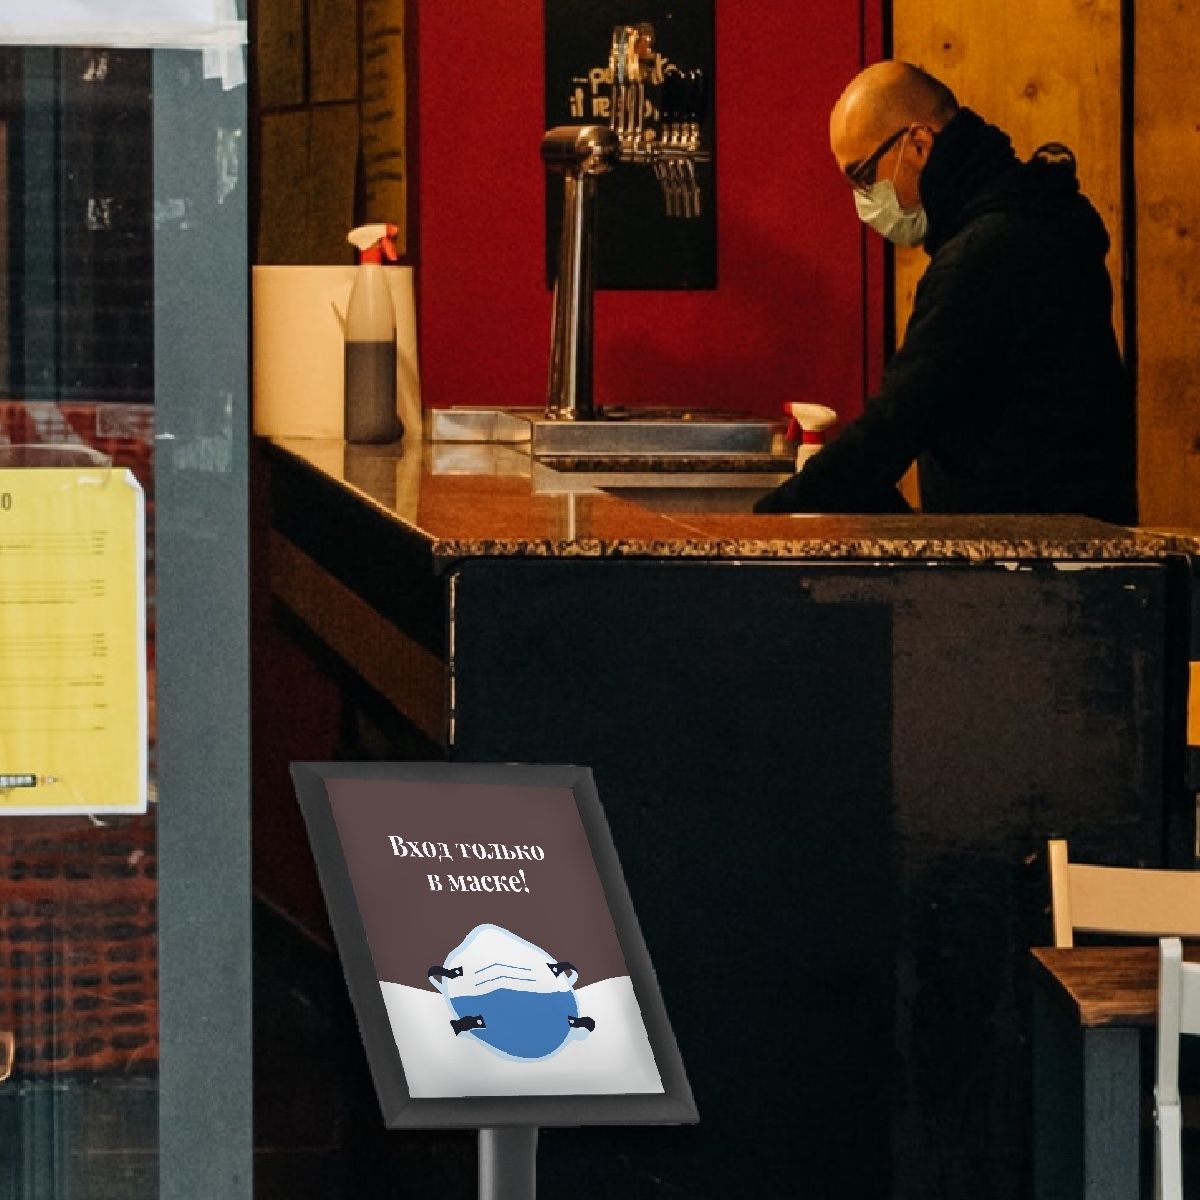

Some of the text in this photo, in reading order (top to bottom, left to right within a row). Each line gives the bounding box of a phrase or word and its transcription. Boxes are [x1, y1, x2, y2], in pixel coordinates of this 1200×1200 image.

[387, 835, 545, 862] Вход только
[427, 868, 530, 894] в маске!
